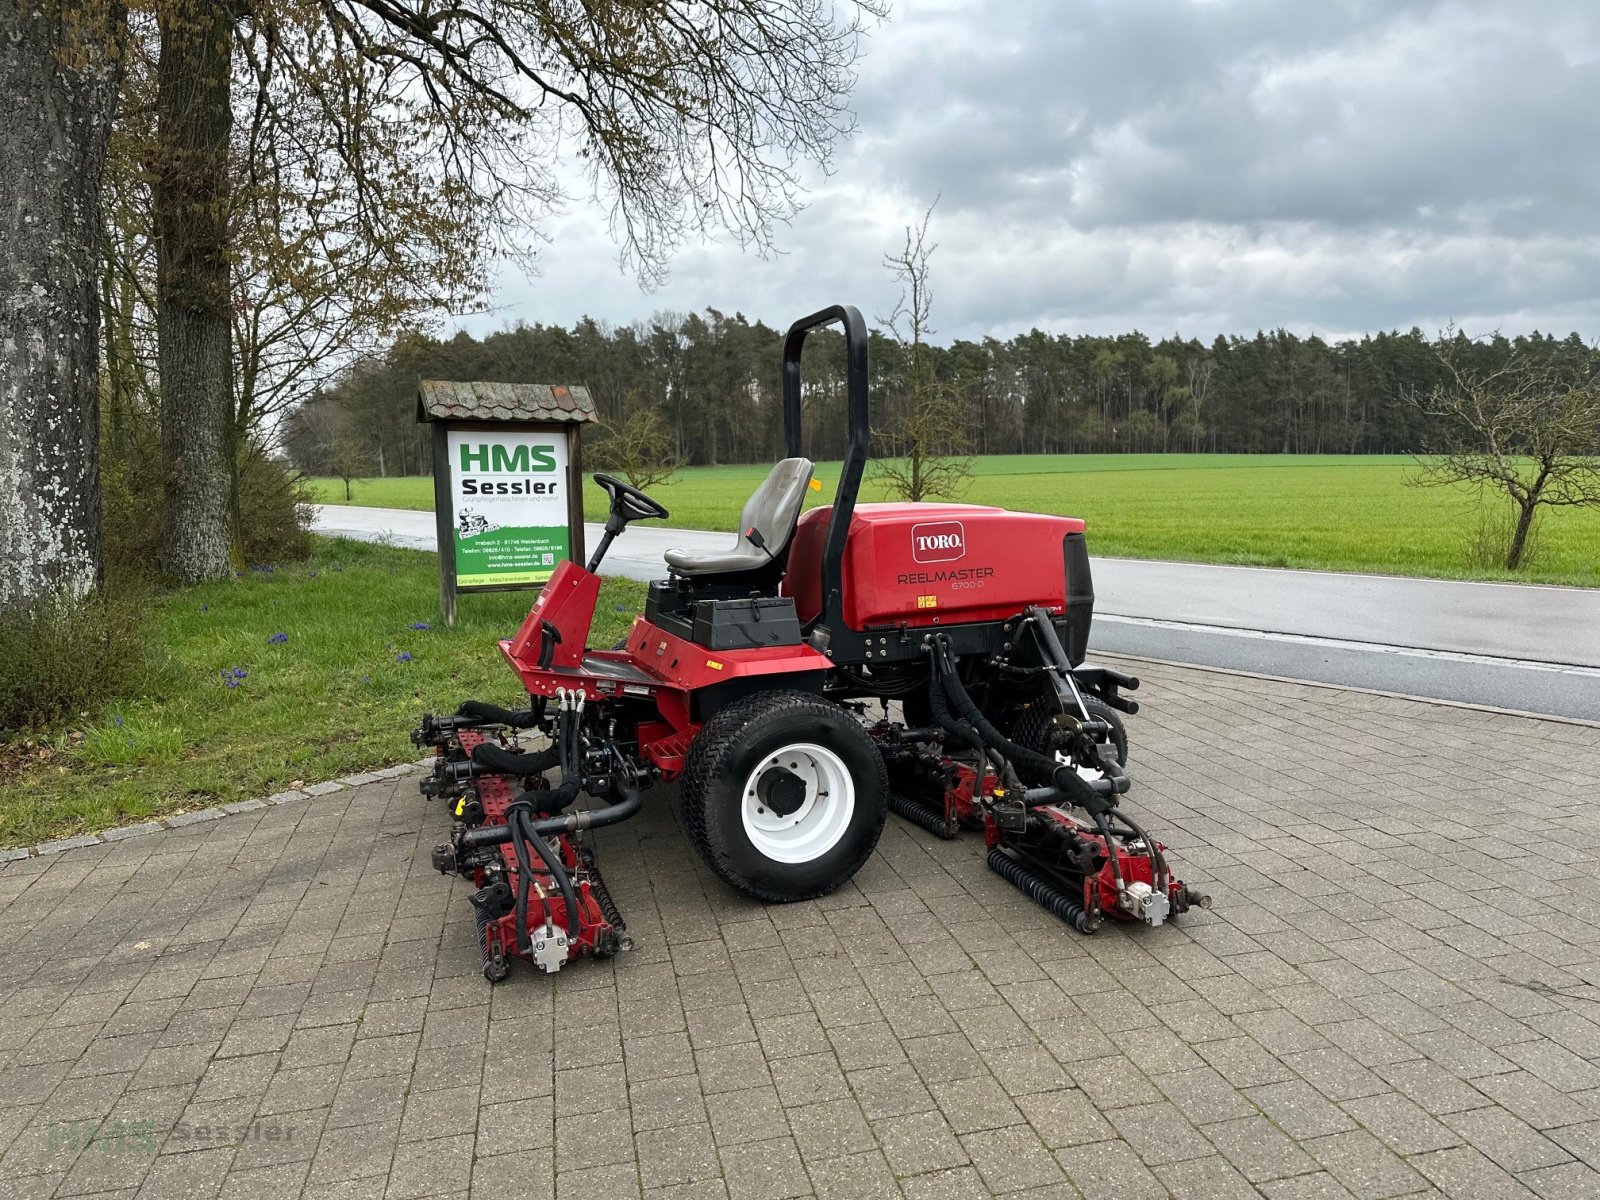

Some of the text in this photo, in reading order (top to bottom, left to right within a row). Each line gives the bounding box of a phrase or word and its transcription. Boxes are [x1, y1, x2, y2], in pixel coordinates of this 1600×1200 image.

[460, 443, 556, 472] HMS
[462, 479, 557, 494] Sessler
[897, 567, 994, 585] REELMASTER
